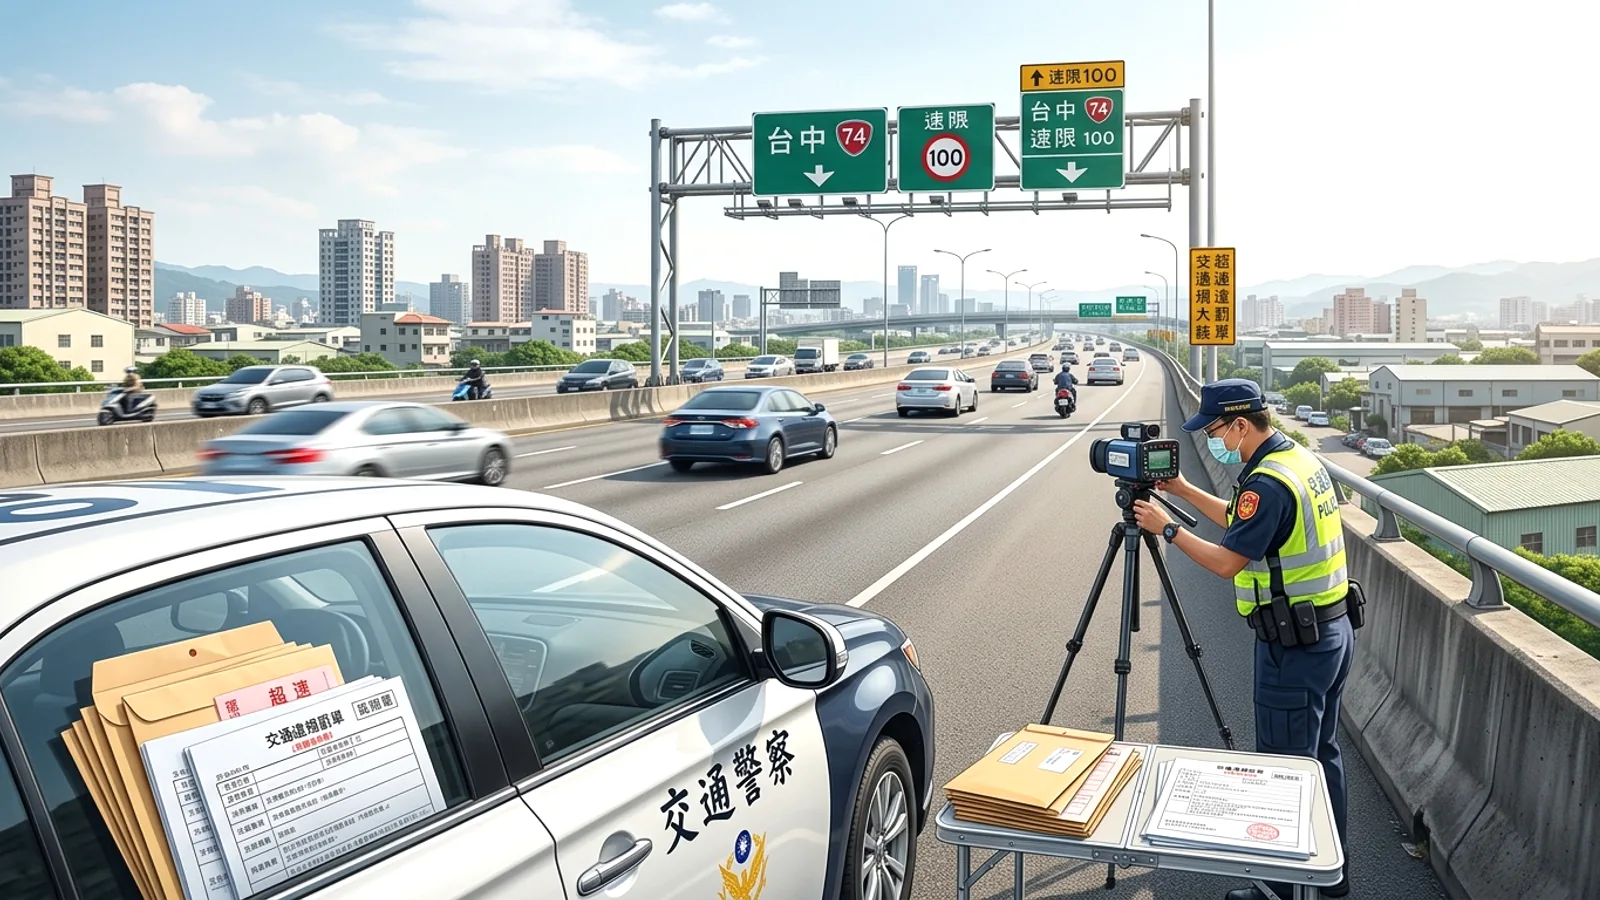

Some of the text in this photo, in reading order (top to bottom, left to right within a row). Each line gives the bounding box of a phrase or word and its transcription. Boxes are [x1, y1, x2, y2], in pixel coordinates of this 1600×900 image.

[1048, 67, 1117, 85] 速限100
[924, 111, 969, 130] 速限
[1030, 101, 1108, 122] 台中 74
[768, 126, 867, 155] 台中 74
[1030, 128, 1115, 148] 速限 100
[929, 149, 963, 167] 100
[269, 680, 311, 706] 超速
[660, 730, 795, 854] 交通警察
